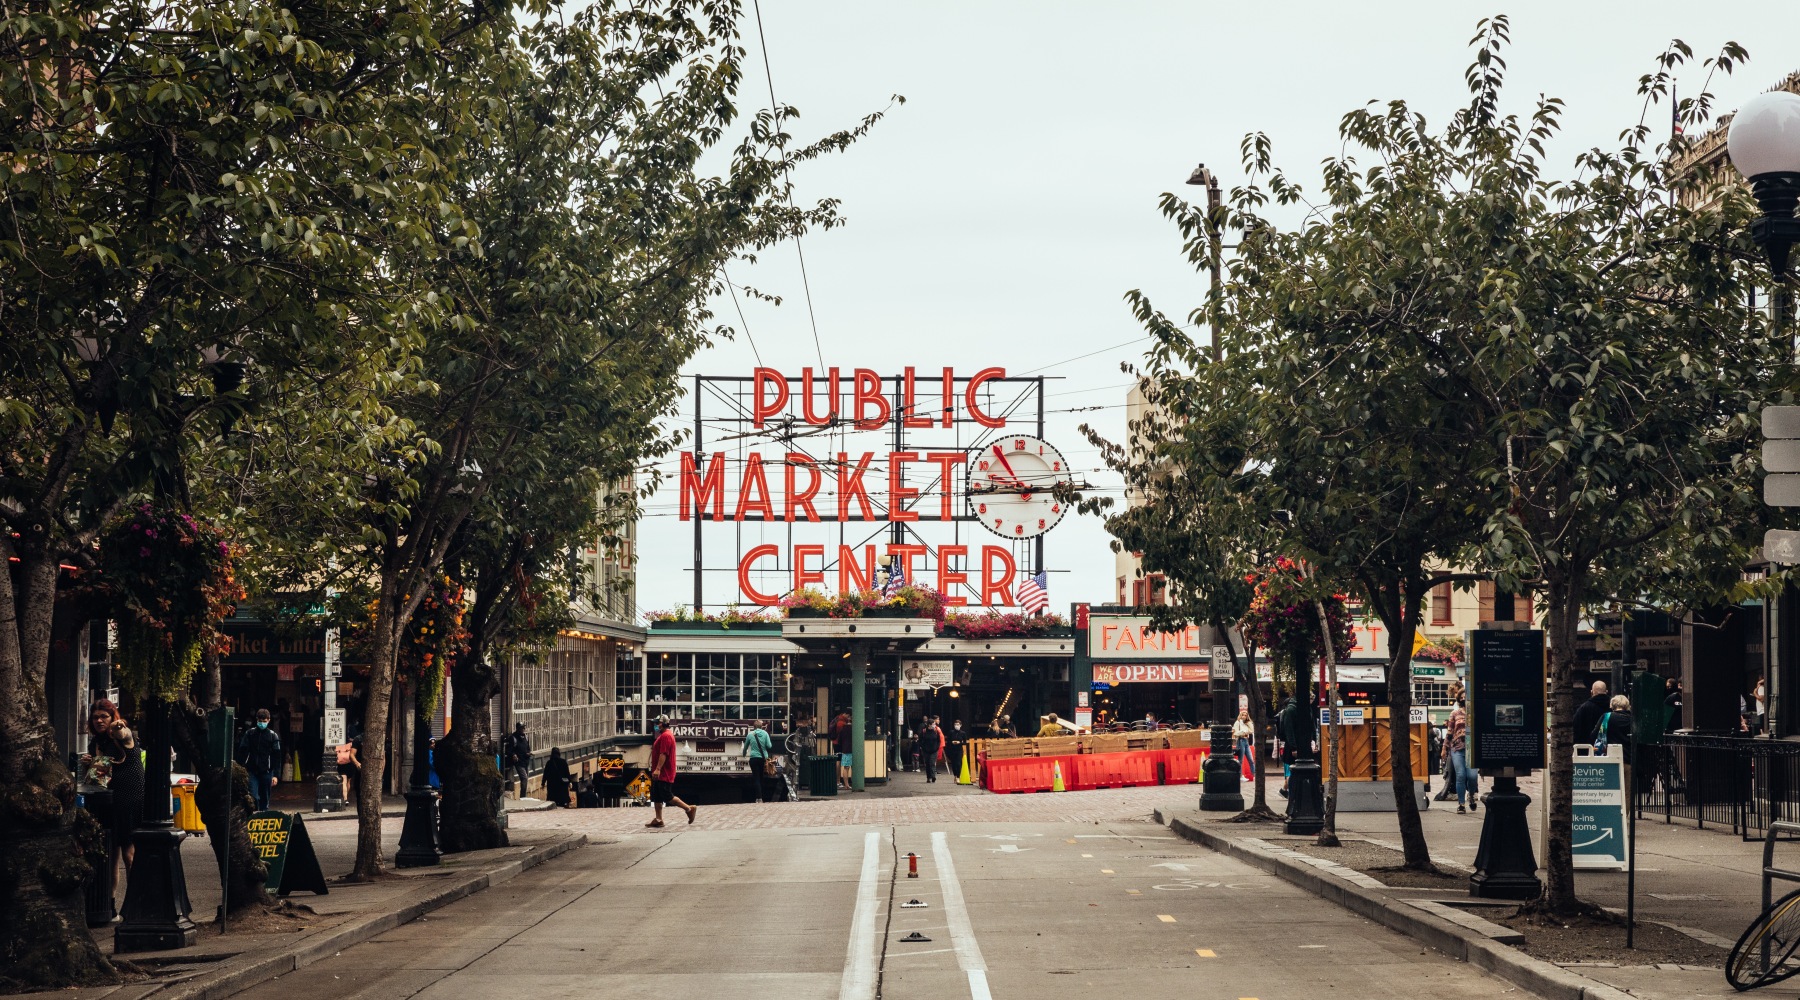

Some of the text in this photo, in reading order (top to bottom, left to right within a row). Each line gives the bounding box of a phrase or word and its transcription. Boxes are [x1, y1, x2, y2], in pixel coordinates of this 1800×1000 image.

[754, 366, 1006, 430] PUBLIC
[1015, 440, 1026, 450] 12
[979, 461, 989, 471] 10
[1053, 461, 1060, 471] 2
[680, 451, 967, 522] MARKET
[979, 503, 986, 514] 8
[1052, 504, 1060, 514] 4
[995, 519, 1002, 529] 7
[1016, 525, 1023, 535] 6
[1039, 519, 1045, 529] 5
[738, 544, 1016, 607] CENTER
[230, 632, 268, 654] rket
[1103, 626, 1199, 650] FARME
[1115, 665, 1182, 680] OPEN!
[712, 727, 754, 736] THEATE
[248, 818, 283, 831] GREEN
[248, 831, 288, 844] RTOISE
[254, 845, 280, 858] TEL
